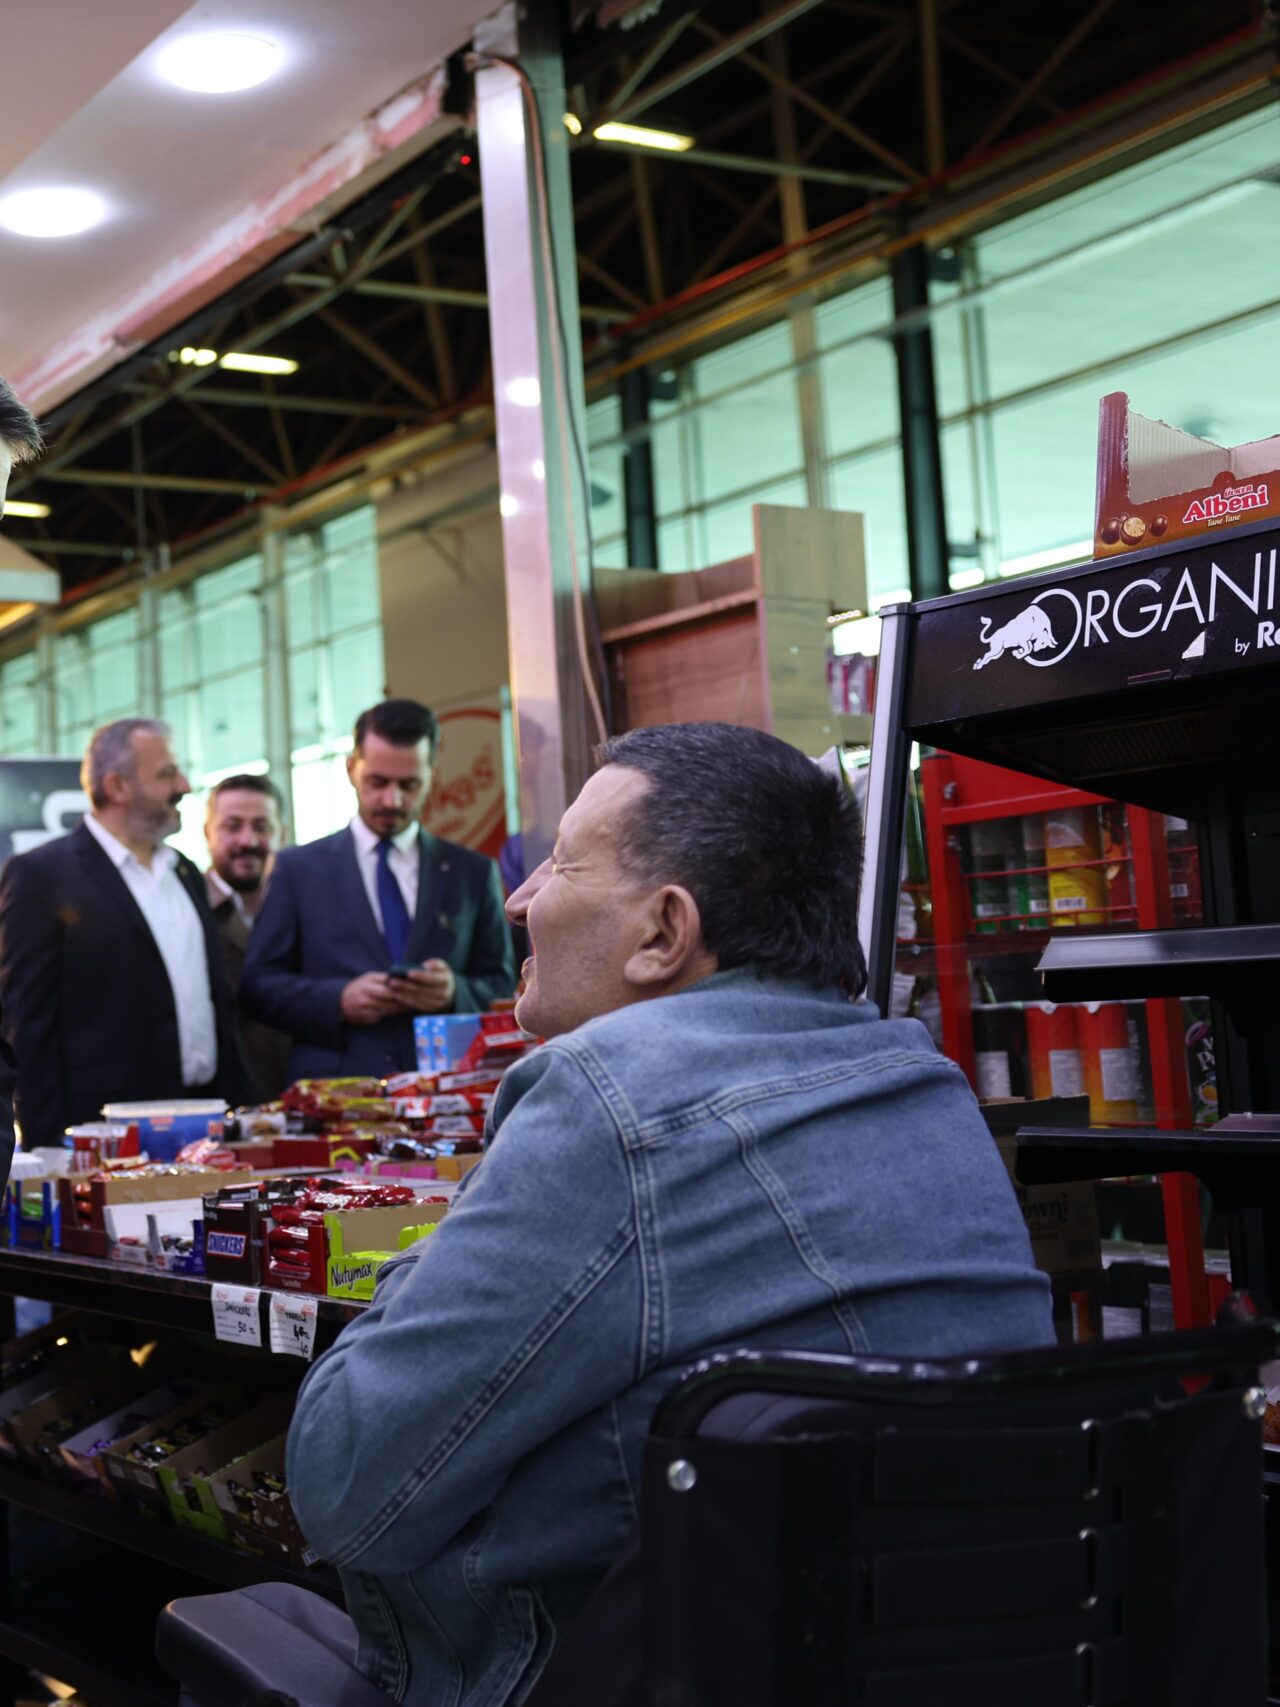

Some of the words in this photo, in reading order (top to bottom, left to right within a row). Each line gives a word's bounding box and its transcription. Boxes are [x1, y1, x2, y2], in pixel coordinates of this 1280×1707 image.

[1224, 485, 1253, 498] ÜLKER
[1182, 484, 1269, 524] Albeni
[1207, 518, 1223, 527] Tane
[1225, 514, 1241, 523] Tane
[1234, 638, 1251, 656] by
[208, 1234, 244, 1256] SNICKERS
[331, 1262, 373, 1291] Nutymax
